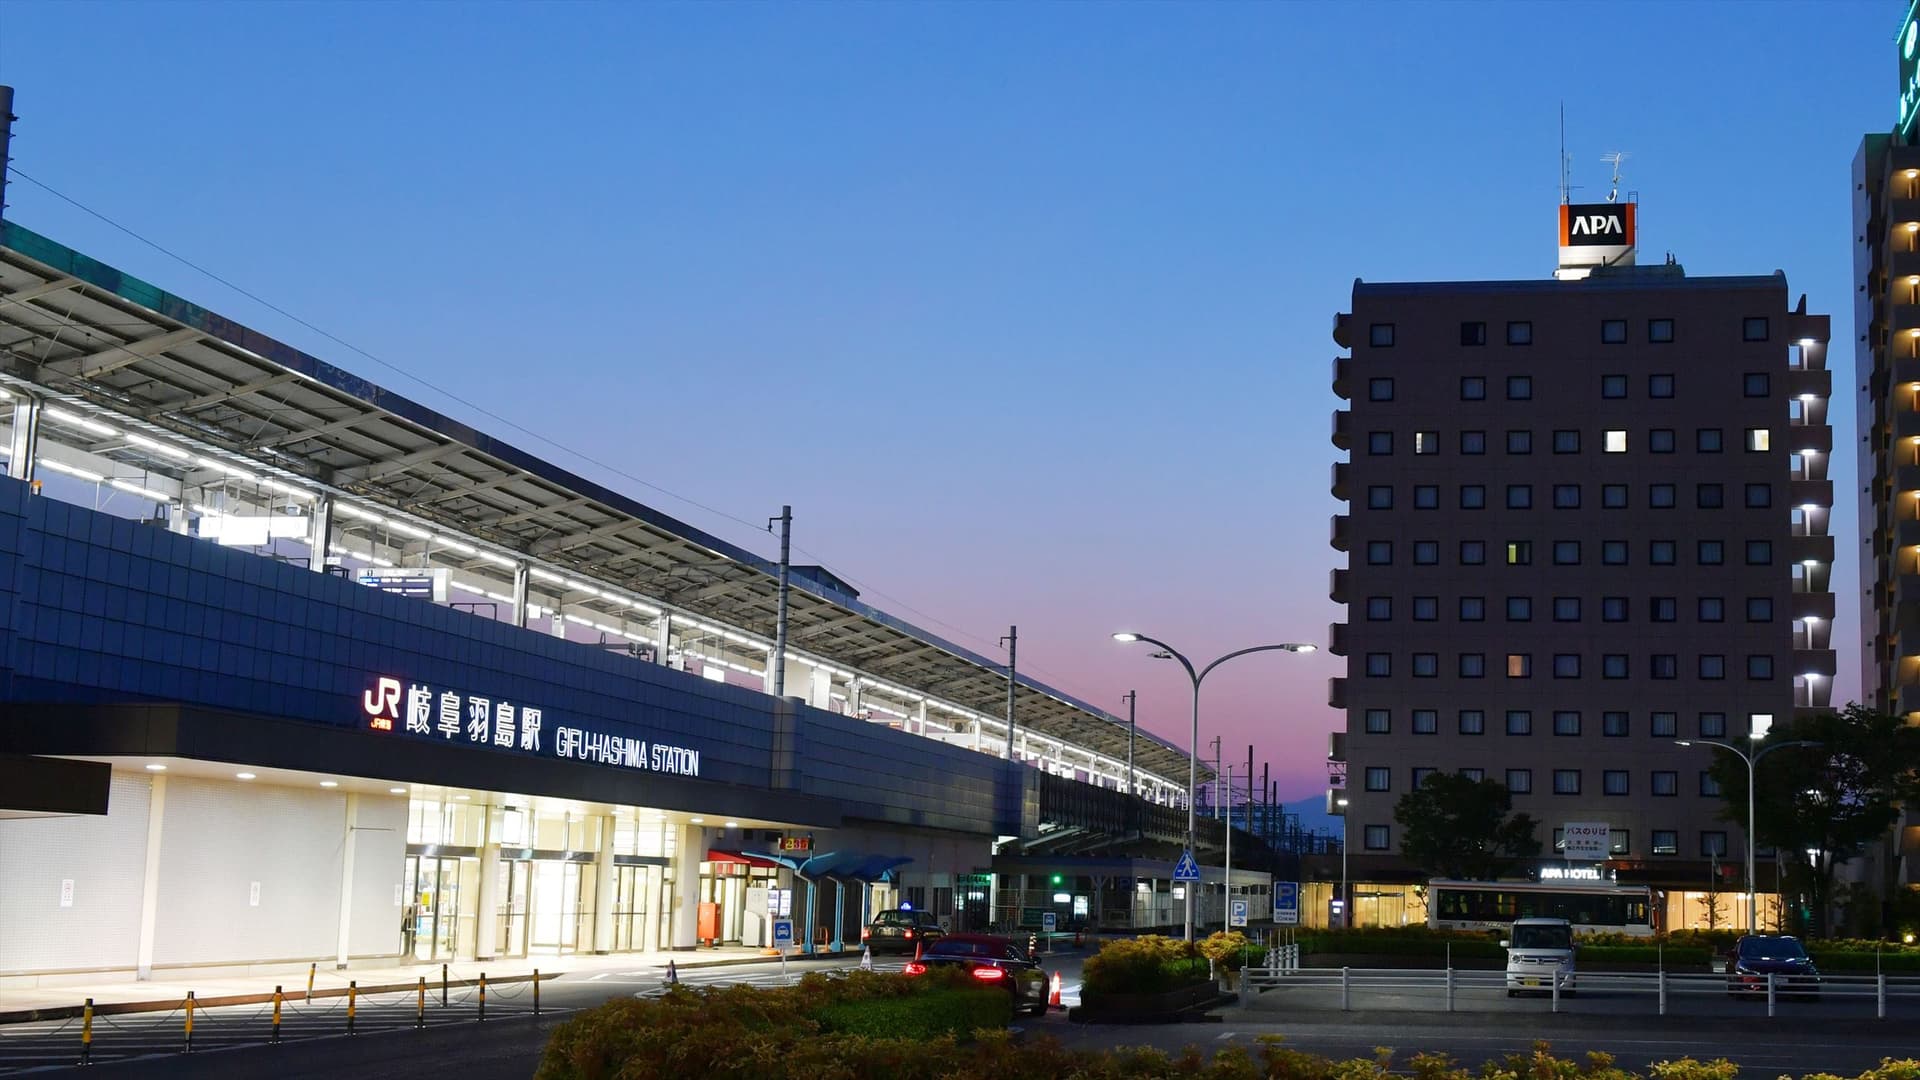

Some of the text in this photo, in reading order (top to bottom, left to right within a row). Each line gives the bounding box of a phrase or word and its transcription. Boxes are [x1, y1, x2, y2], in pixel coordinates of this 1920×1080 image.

[1571, 215, 1623, 235] APA
[364, 677, 401, 718] JR
[406, 683, 542, 752] 岐阜羽島駅
[556, 726, 700, 777] GIFU-HASHIMA STATION
[1566, 827, 1607, 836] バスのりば
[1541, 868, 1600, 880] APA HOTEL
[1277, 885, 1294, 901] P
[1234, 903, 1245, 915] P
